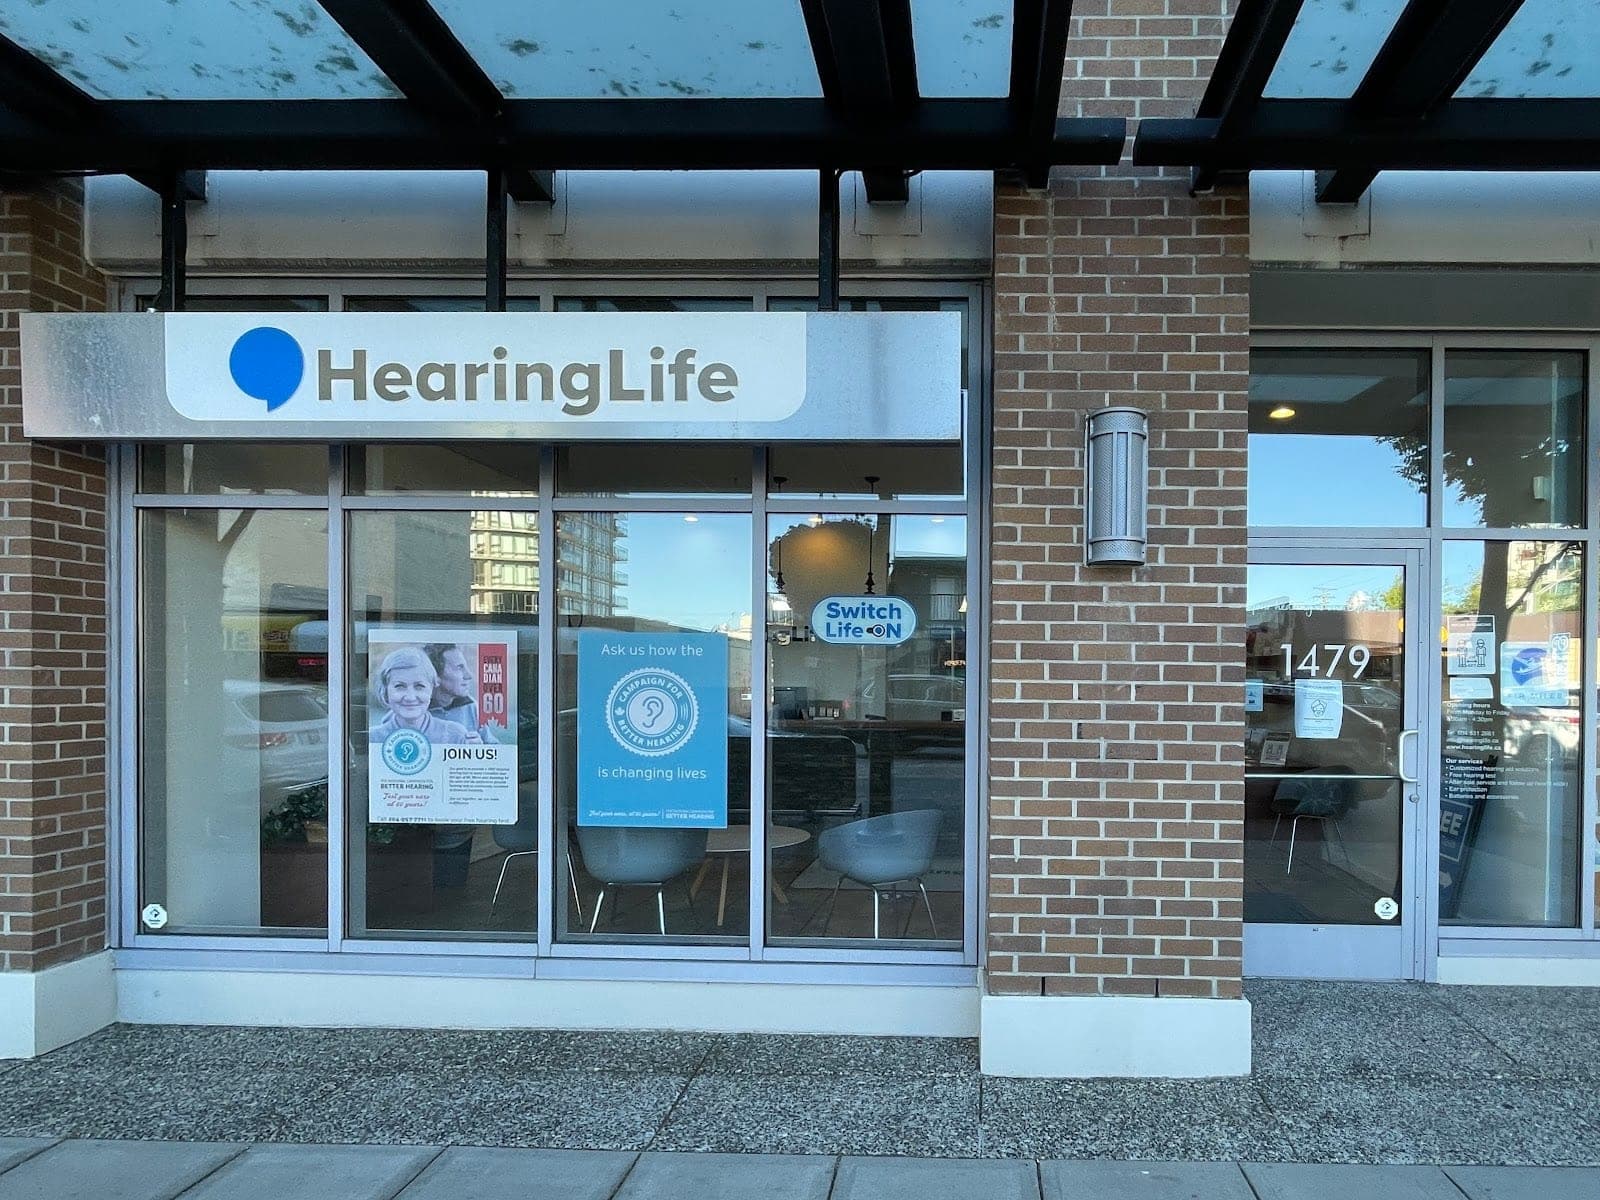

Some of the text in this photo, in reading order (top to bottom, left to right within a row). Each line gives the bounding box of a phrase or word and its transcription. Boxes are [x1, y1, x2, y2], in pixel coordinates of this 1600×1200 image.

[317, 346, 739, 416] HearingLife
[826, 602, 901, 619] Switch
[826, 622, 864, 638] Life
[601, 644, 704, 657] Ask us how the
[483, 663, 503, 674] CANA
[1281, 643, 1370, 679] 1479
[483, 673, 503, 683] DIAN
[620, 677, 684, 702] CAMPAIGN FOR
[482, 692, 504, 714] 60
[1446, 702, 1472, 710] Opening
[1462, 709, 1485, 717] Monday
[1493, 709, 1511, 717] Friday
[618, 719, 685, 747] BETTER HEARING
[443, 748, 498, 761] JOIN US!
[1446, 744, 1502, 752] www.hearinglife.ca
[598, 766, 707, 781] is changing lives
